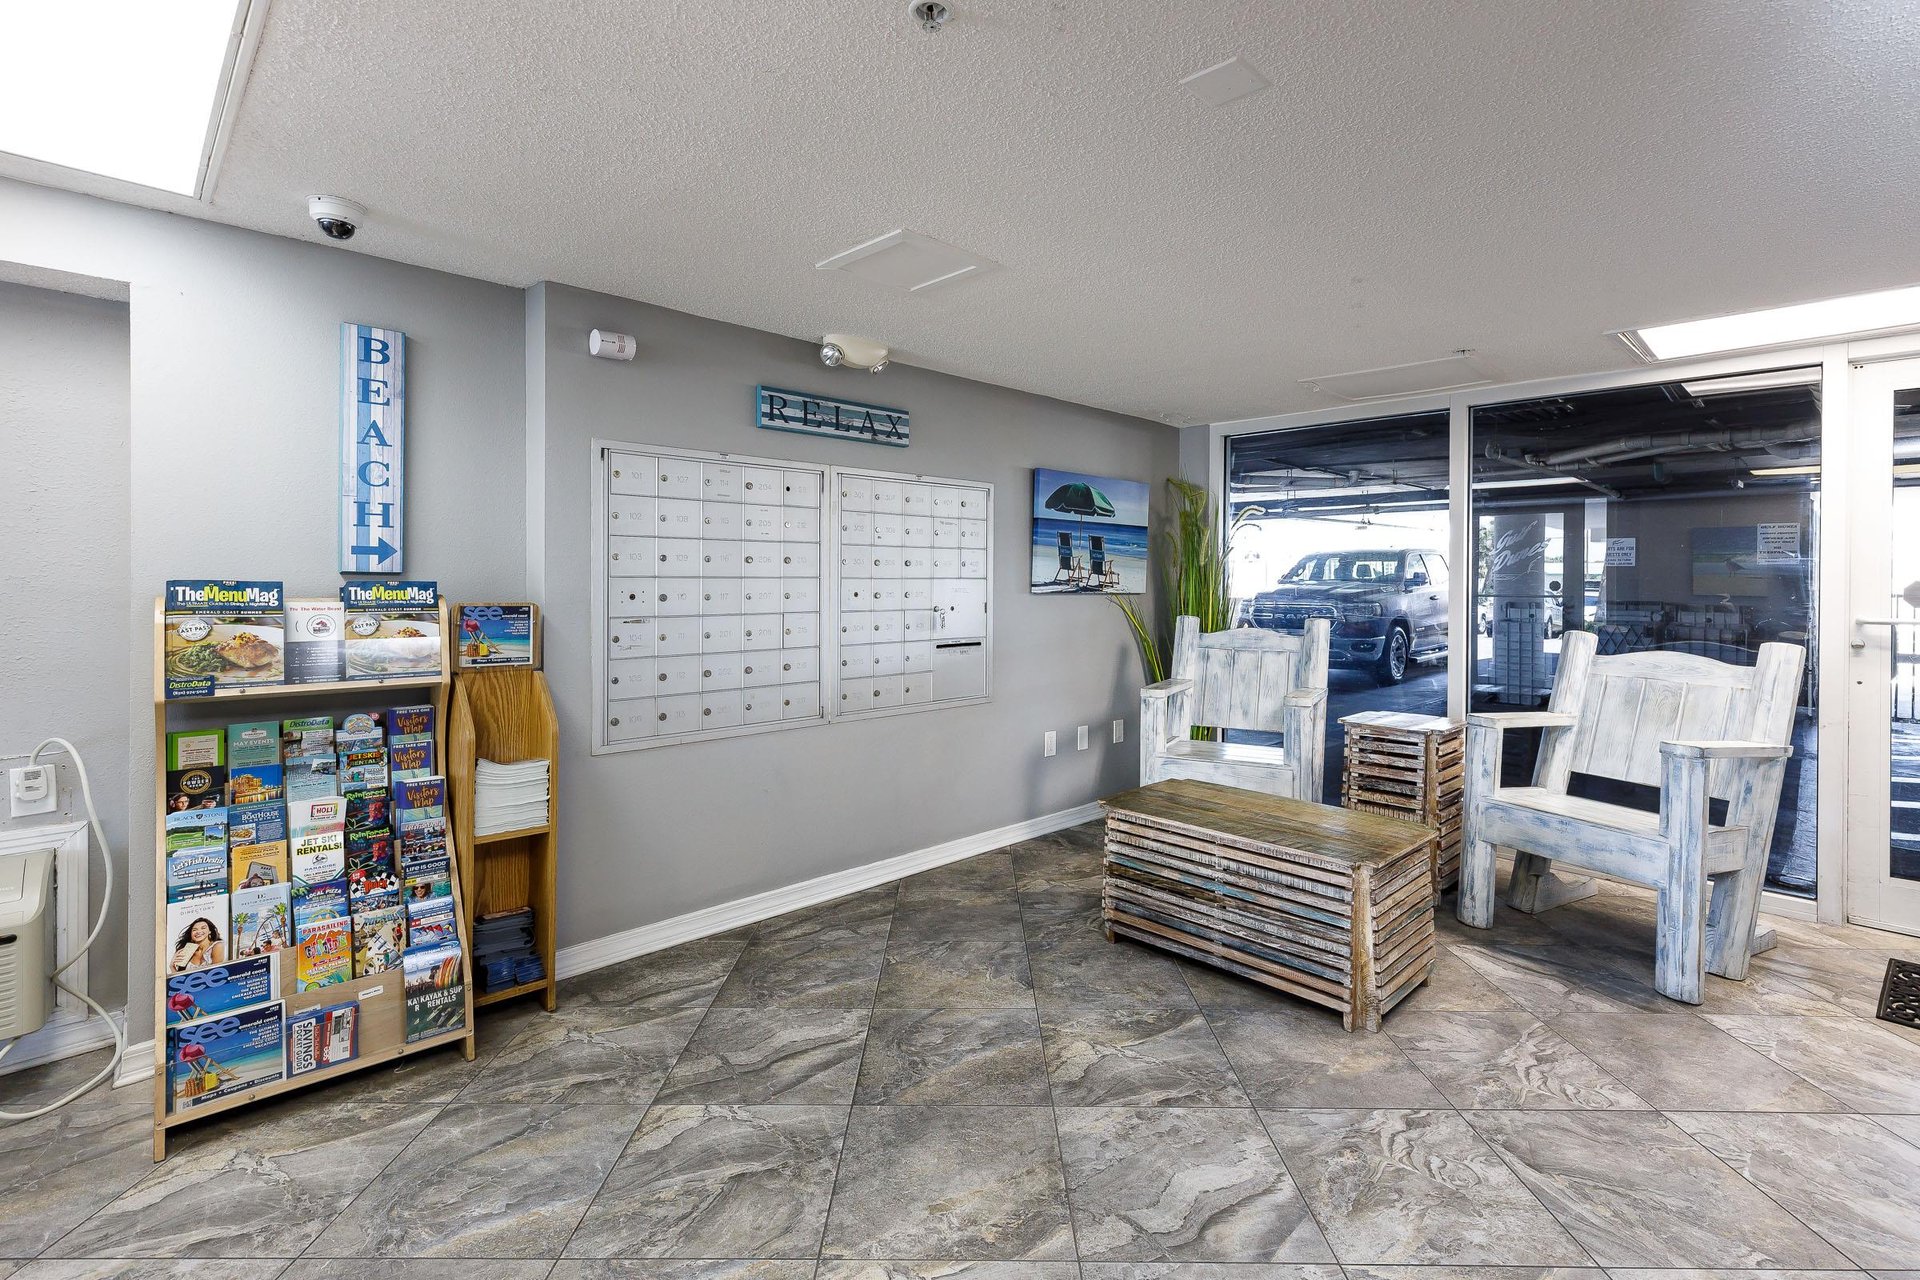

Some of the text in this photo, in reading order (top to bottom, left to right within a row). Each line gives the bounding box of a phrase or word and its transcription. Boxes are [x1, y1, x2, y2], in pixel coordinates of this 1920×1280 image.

[768, 394, 903, 440] RELAX
[352, 335, 395, 529] BEACH
[631, 472, 643, 480] 101
[719, 479, 729, 487] 114
[758, 483, 772, 491] 204
[676, 515, 689, 523] 108
[629, 553, 643, 561] 103
[676, 554, 688, 562] 109
[758, 556, 772, 564] 206
[1492, 538, 1551, 572] Dunes
[175, 584, 280, 606] TheMenuMag
[349, 584, 434, 604] TheMenuMag
[464, 606, 503, 620] see
[169, 680, 211, 689] DistroData
[290, 719, 330, 728] DistroData
[397, 714, 429, 727] Visitors
[250, 738, 274, 746] EVENTS
[394, 748, 426, 762] Visitors
[407, 786, 439, 800] Visitors
[242, 811, 279, 821] BOATHOUSE
[301, 834, 337, 847] JET SKI
[297, 842, 342, 856] RENTALS!
[172, 856, 225, 872] Let's Fish Destin
[306, 891, 324, 900] LOCAL
[181, 906, 214, 916] DIRECTORY
[302, 920, 348, 934] PARASAILING
[168, 968, 229, 996] see
[228, 971, 251, 980] emerald
[231, 991, 253, 999] EMERALD
[420, 990, 442, 1004] KAYAK
[449, 985, 463, 995] SUP
[427, 994, 456, 1008] RENTALS
[239, 1019, 262, 1029] emerald
[259, 1024, 279, 1032] ULTIMATE
[180, 1017, 240, 1047] see
[242, 1035, 279, 1049] EMERALD COAST
[302, 1022, 313, 1069] SAVINGS
[223, 1082, 248, 1092] Coupons
[254, 1074, 280, 1084] Discounts
